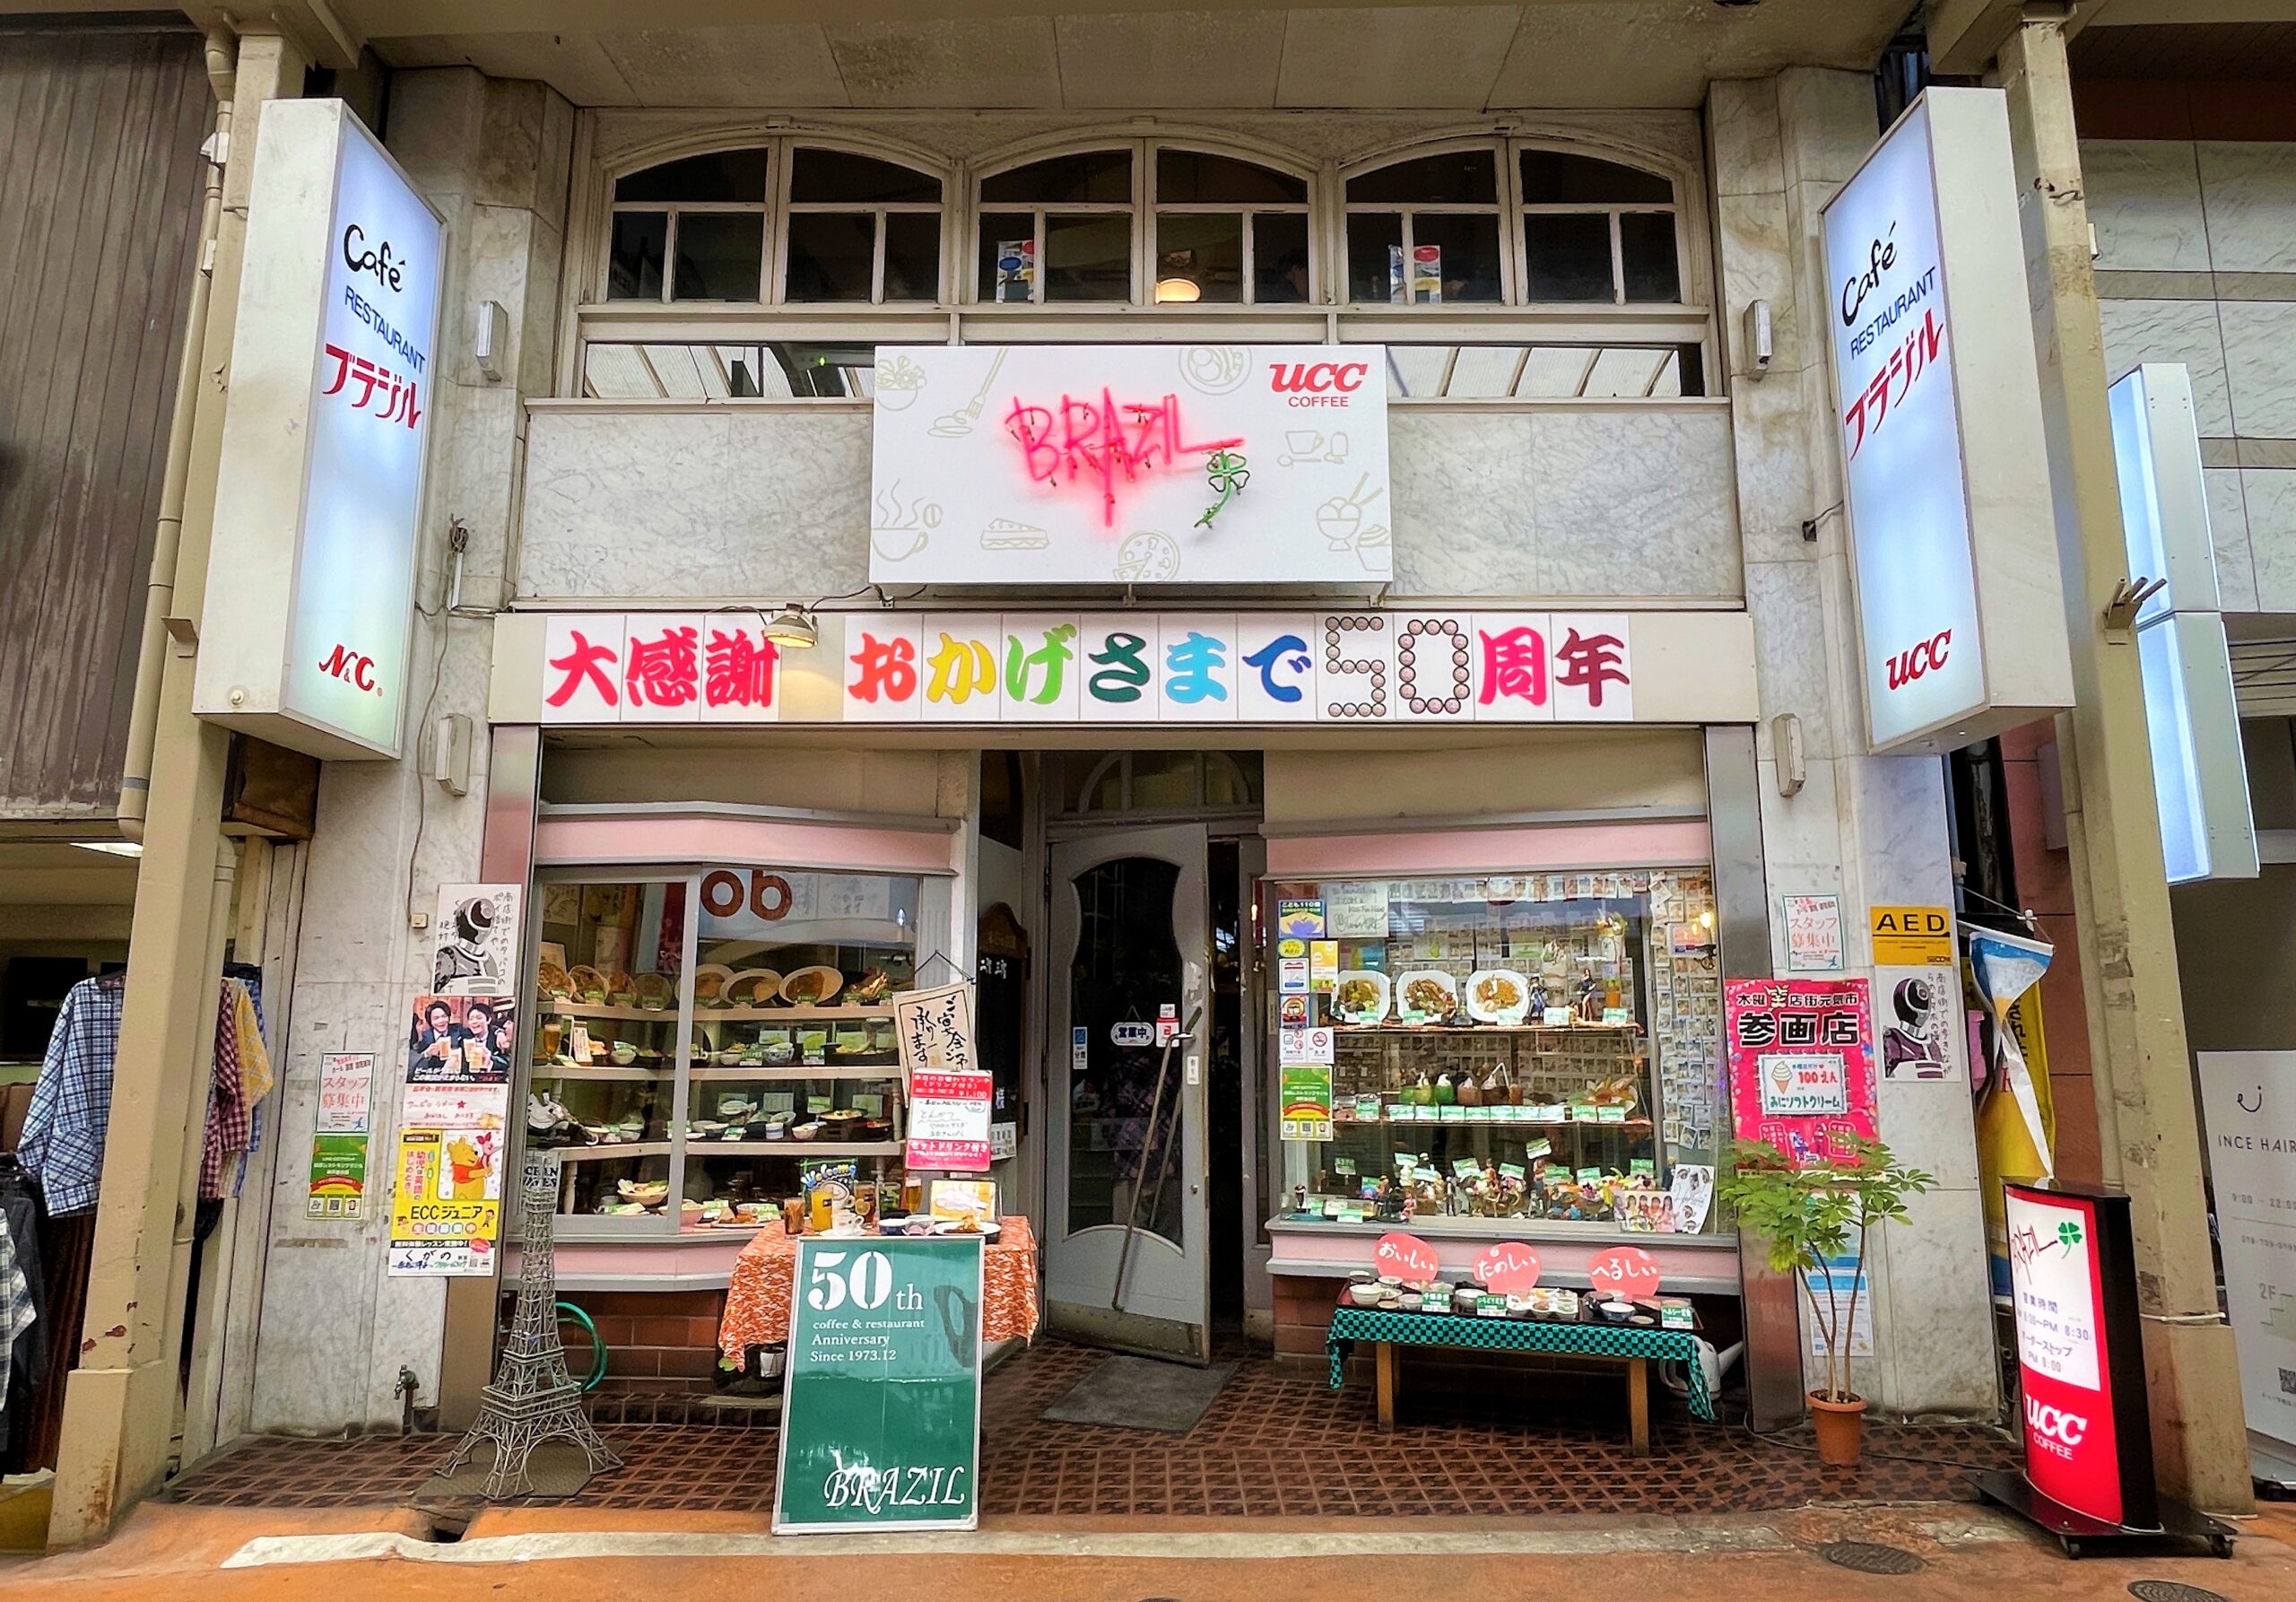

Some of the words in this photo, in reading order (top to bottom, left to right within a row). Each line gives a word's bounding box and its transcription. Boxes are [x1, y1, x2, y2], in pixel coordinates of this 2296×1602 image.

[344, 223, 407, 293] Café
[1841, 220, 1897, 326] Café
[1849, 266, 1936, 360] RESTAURANT
[344, 284, 426, 374] RESTAURANT
[323, 343, 422, 430] ブラジル
[1845, 307, 1944, 461] ブラジル
[1288, 396, 1350, 408] COFFEE
[1004, 384, 1247, 527] BRAZIL
[545, 625, 779, 709] 大感謝
[1790, 917, 1838, 929] スタッフ
[1876, 913, 1945, 932] AED
[1118, 1026, 1147, 1038] 営業中
[1738, 1012, 1859, 1047] 参画店
[323, 1075, 370, 1091] スタッフ
[1378, 1241, 1435, 1273] おいしい
[1478, 1251, 1537, 1279] たのしい
[1591, 1257, 1659, 1281] へるしい
[2259, 1283, 2276, 1300] 2F
[813, 1319, 848, 1329] coffee
[852, 1319, 861, 1328] &
[865, 1319, 925, 1328] restaurant
[812, 1334, 890, 1348] Anniversary
[810, 1351, 844, 1363] Since
[848, 1349, 897, 1362] 1973.12
[2033, 1432, 2074, 1461] COFFEE
[823, 1466, 966, 1514] BRAZIL
